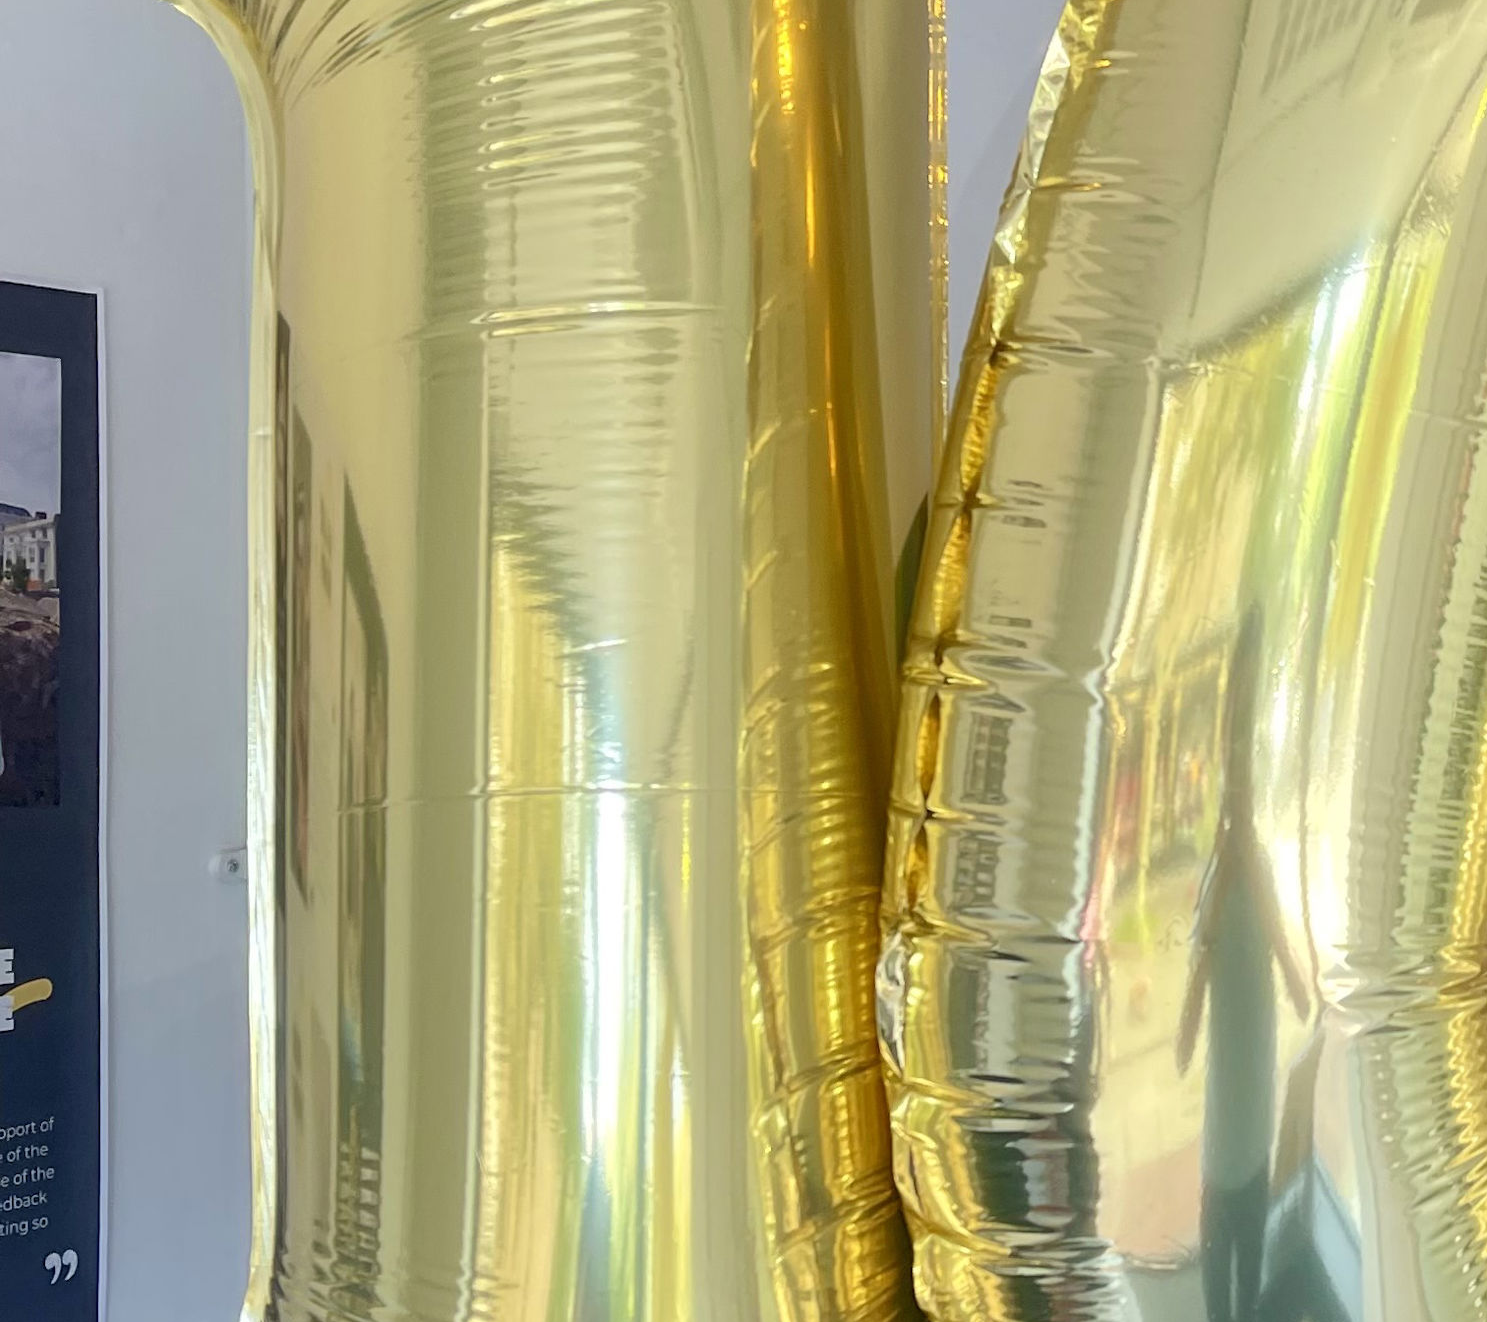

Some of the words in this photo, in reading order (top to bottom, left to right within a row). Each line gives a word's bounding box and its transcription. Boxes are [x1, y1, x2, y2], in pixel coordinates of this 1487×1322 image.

[40, 1116, 55, 1132] of
[6, 1145, 21, 1163] of
[24, 1144, 49, 1160] the
[13, 1168, 28, 1186] of
[30, 1166, 55, 1182] the
[31, 1217, 49, 1230] so
